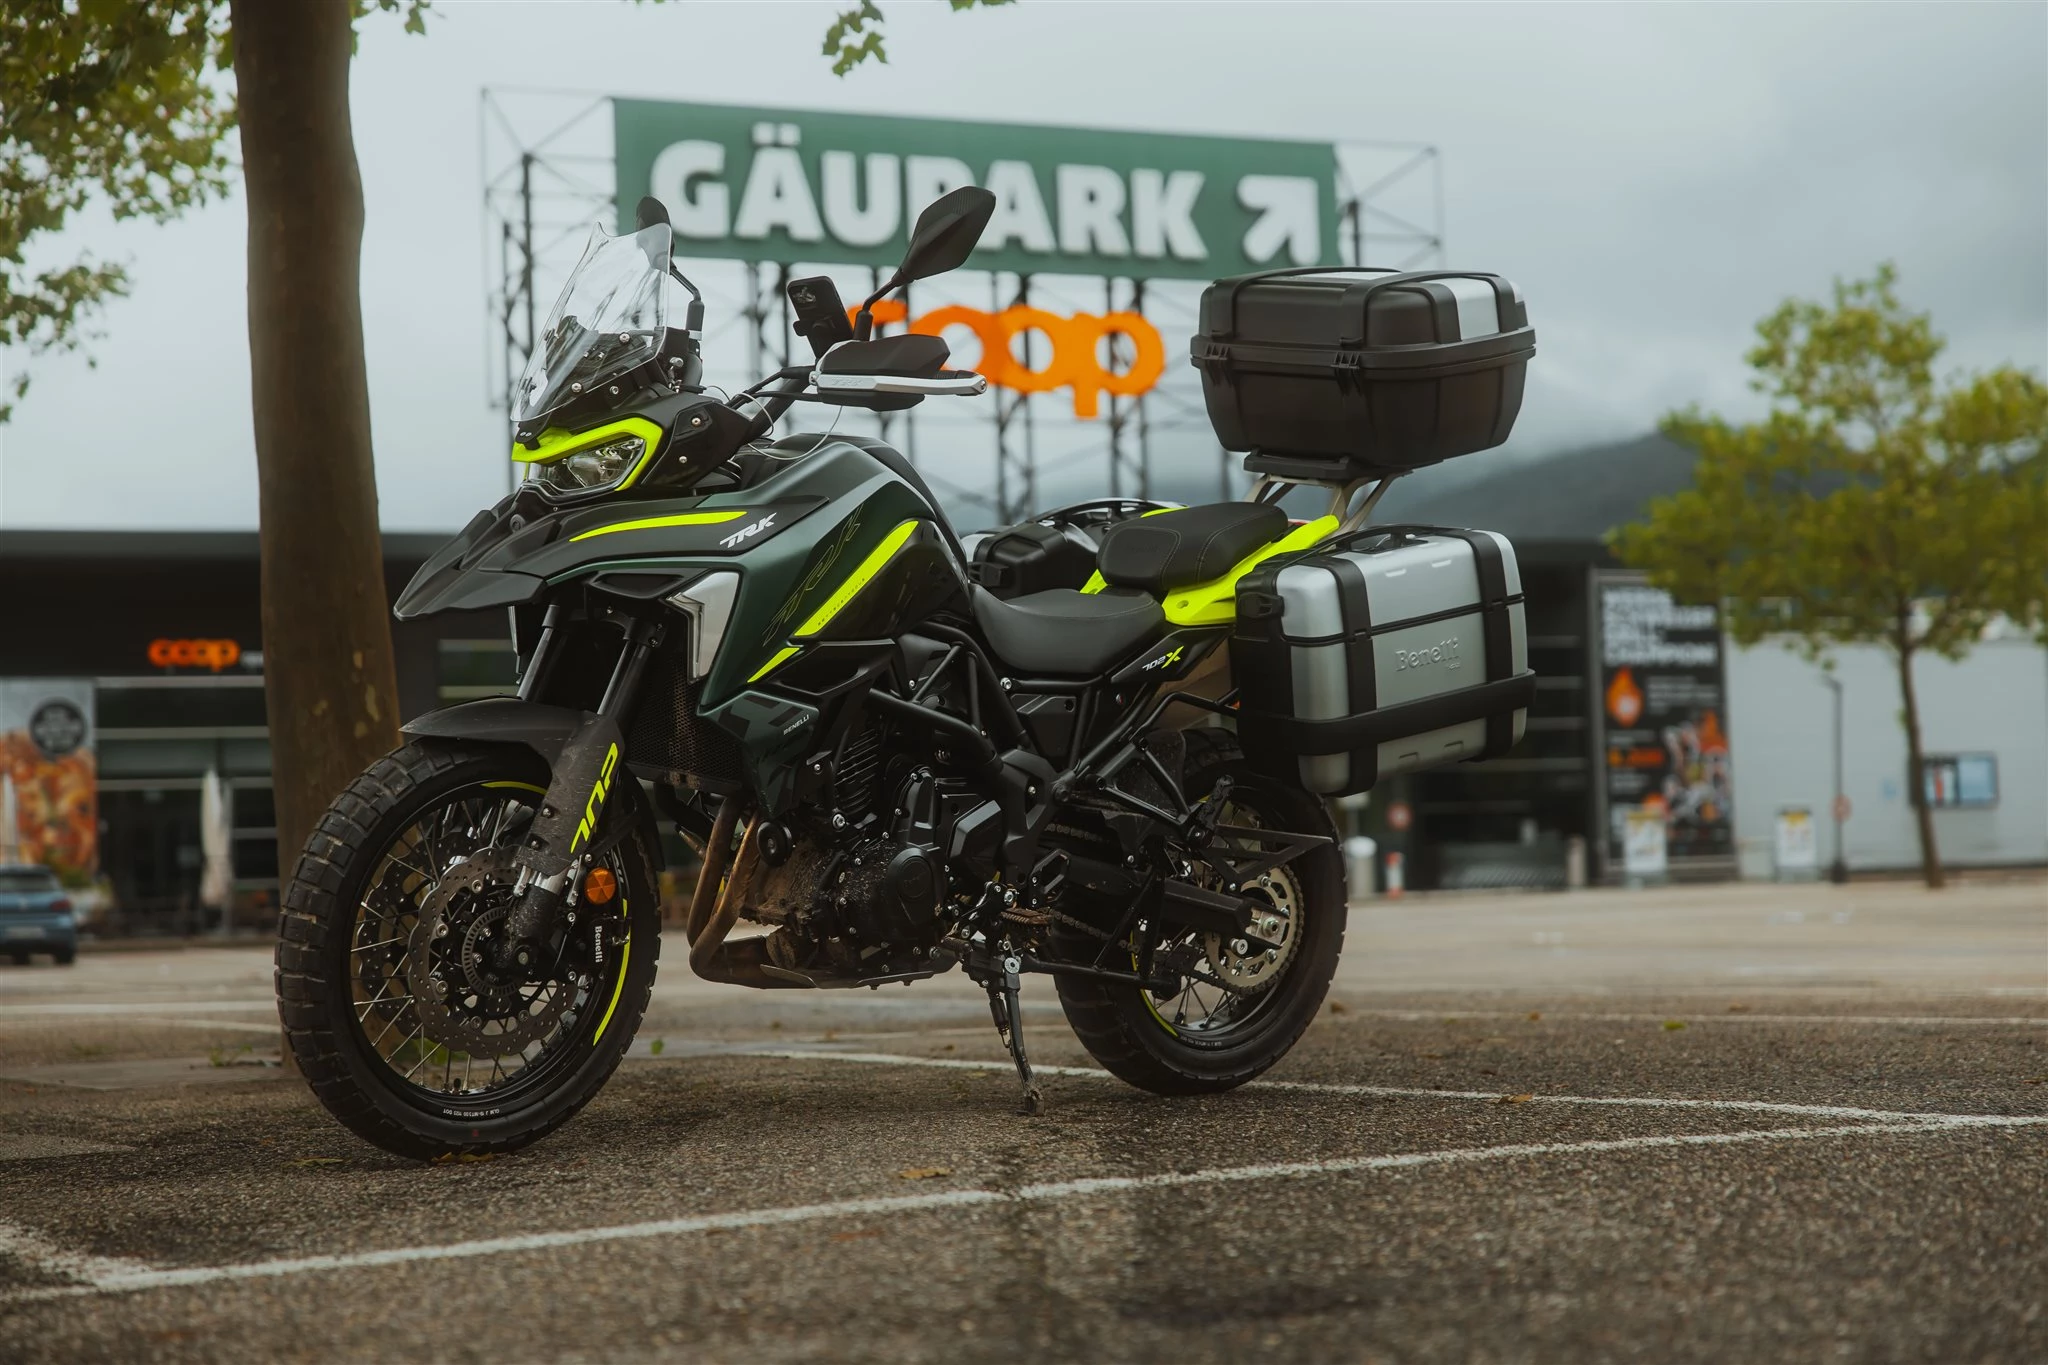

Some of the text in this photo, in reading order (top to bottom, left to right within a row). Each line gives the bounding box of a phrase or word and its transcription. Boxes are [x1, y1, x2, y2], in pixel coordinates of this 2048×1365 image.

[649, 121, 1208, 260] GÄUPARK
[847, 299, 1164, 420] oop
[719, 511, 778, 549] TRK
[1394, 636, 1460, 672] Benelli
[783, 713, 810, 736] BENELLI
[594, 925, 603, 963] Benelli
